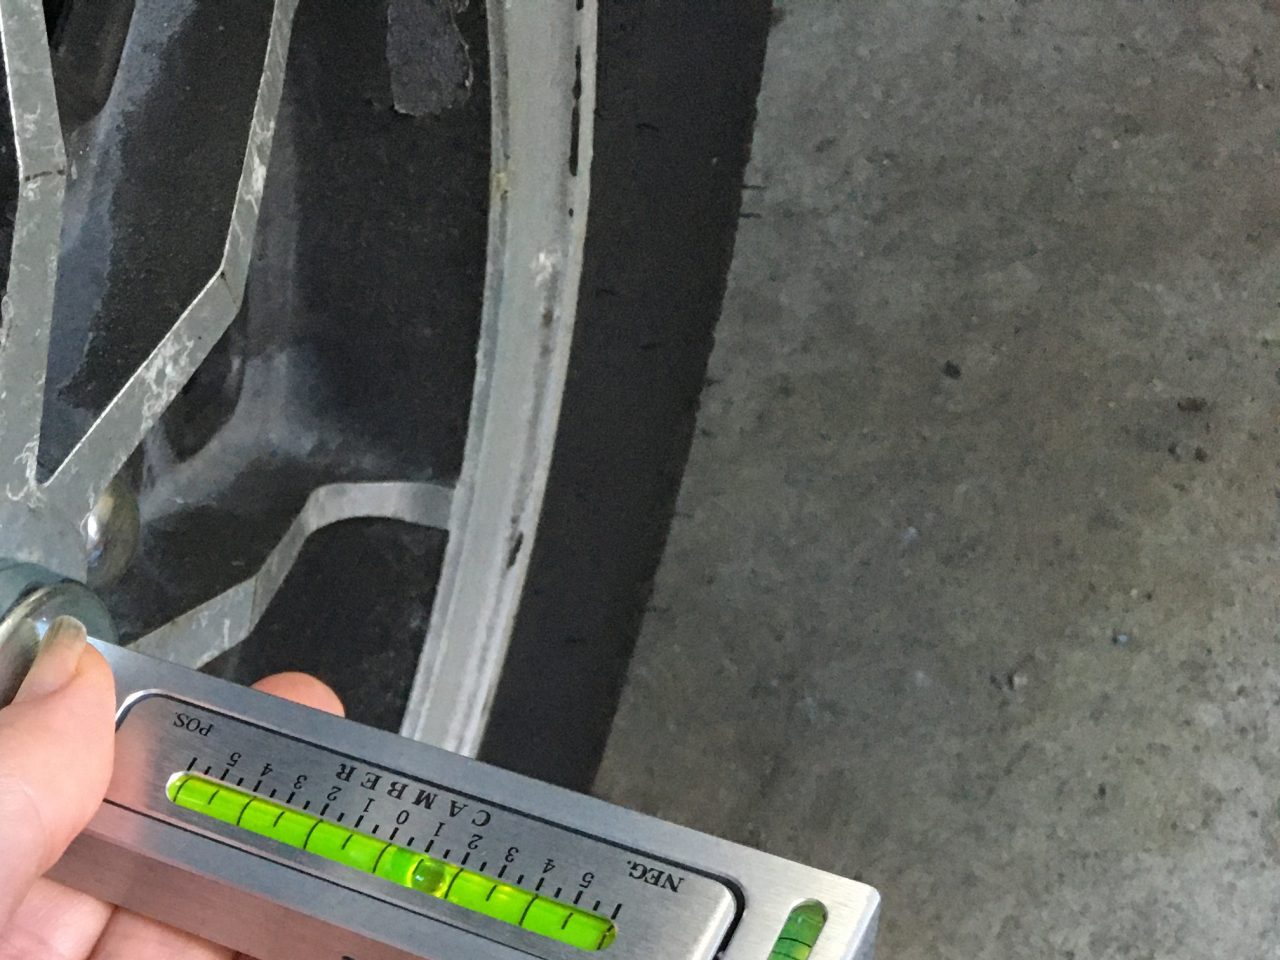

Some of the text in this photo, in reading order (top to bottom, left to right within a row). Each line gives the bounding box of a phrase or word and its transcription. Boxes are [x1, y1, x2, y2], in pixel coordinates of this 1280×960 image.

[226, 752, 595, 888] 5 4 3 2 1 0 1 2 3 4 5
[335, 763, 492, 827] CAMBER
[627, 860, 685, 893] NEG.
